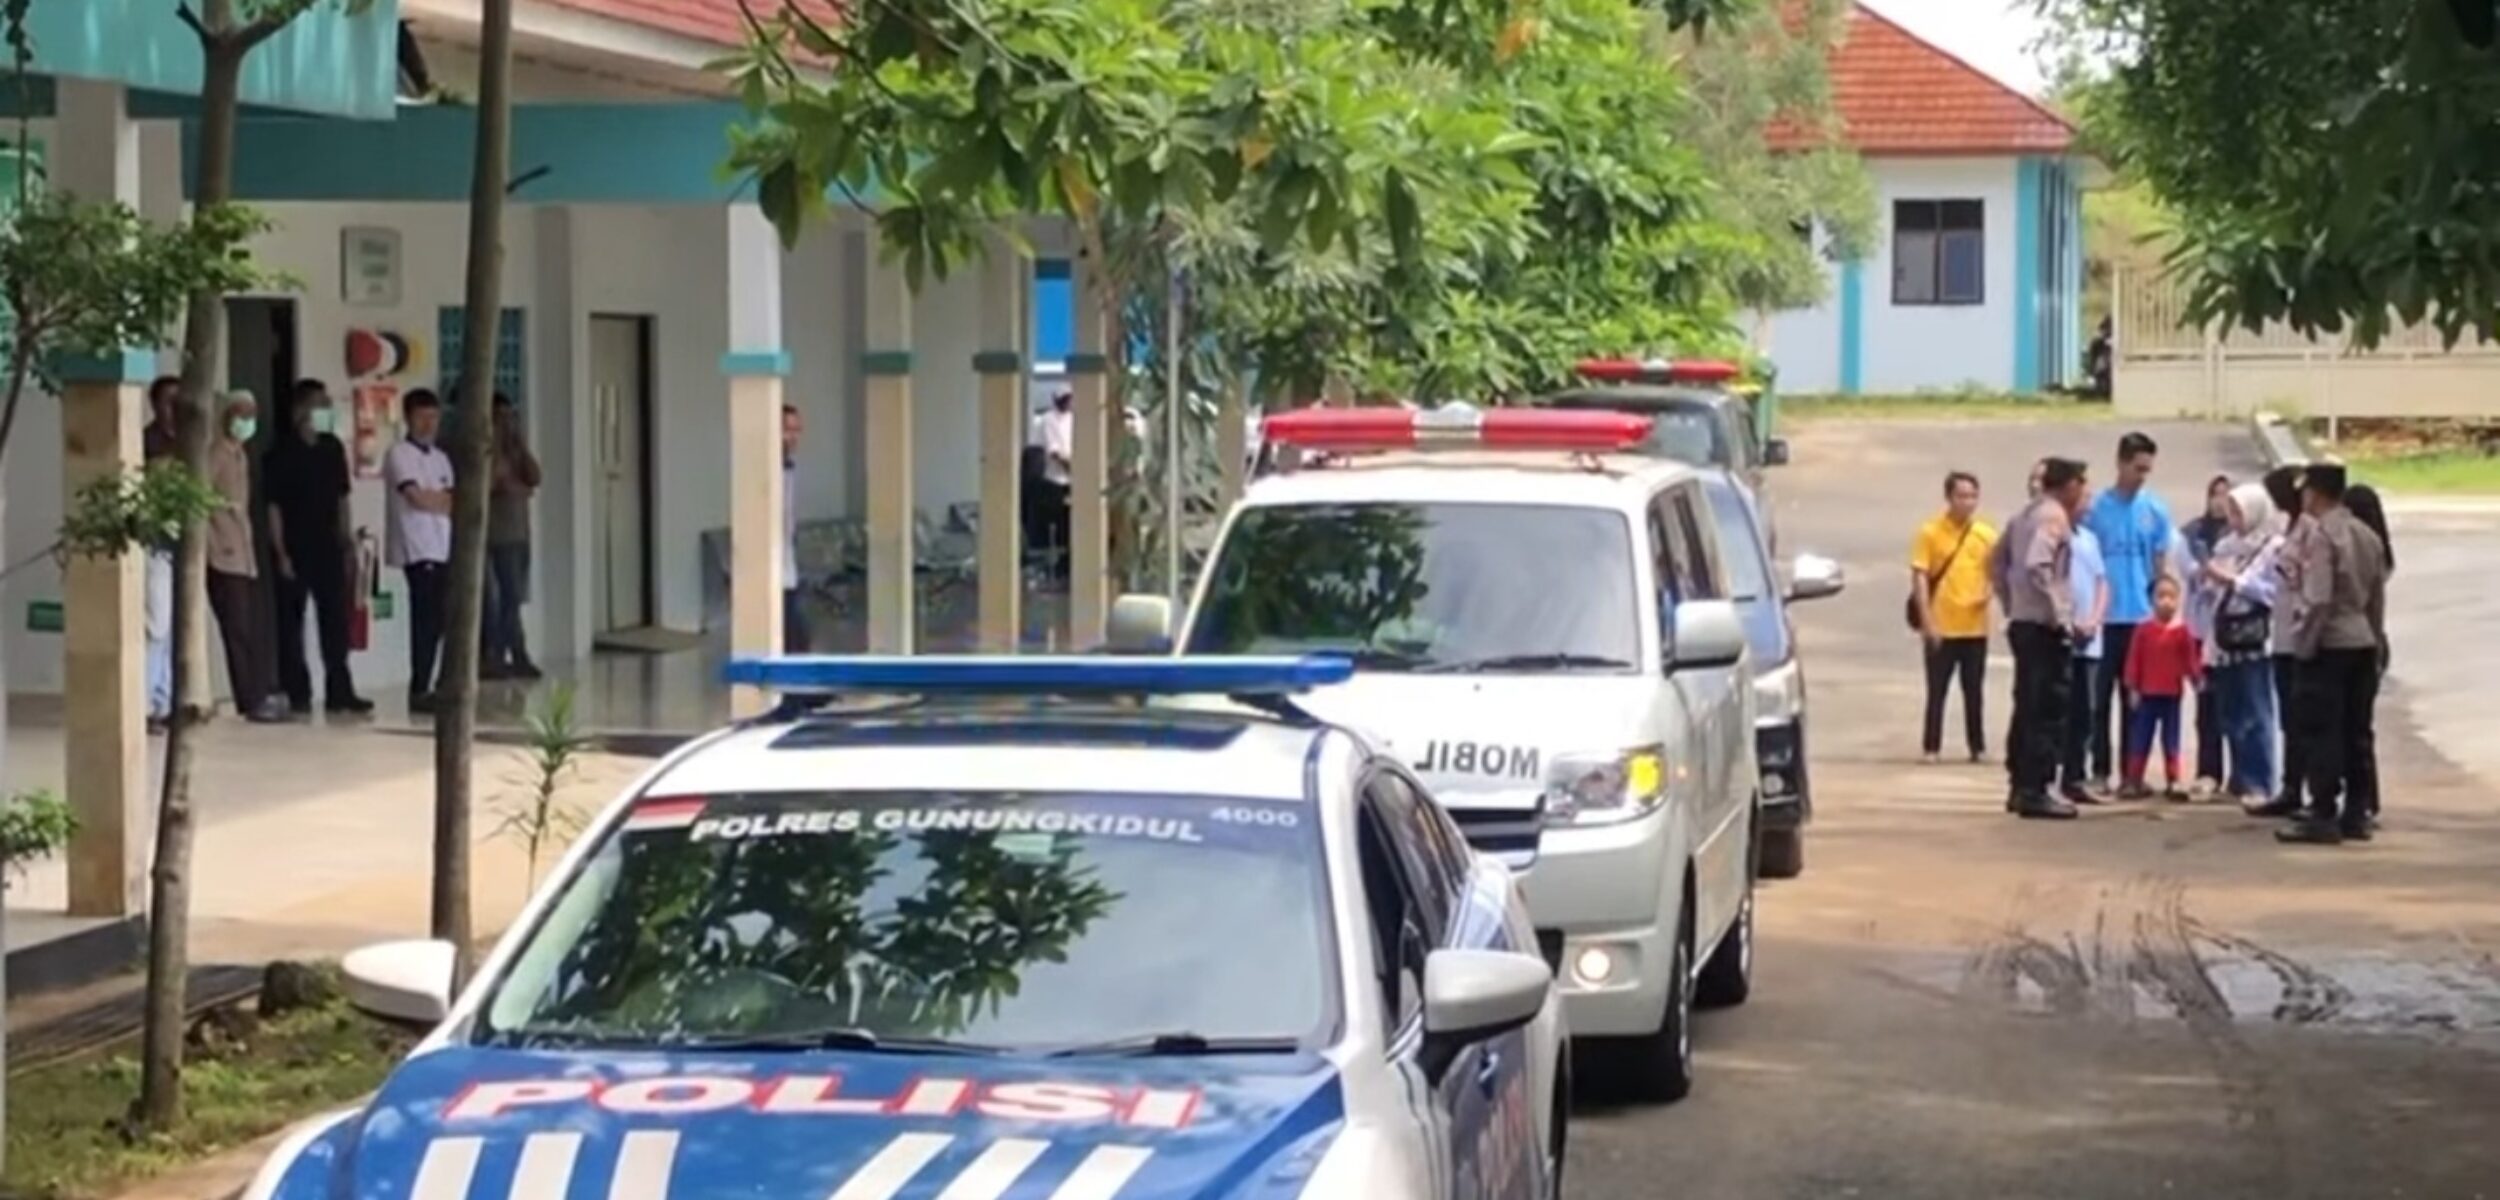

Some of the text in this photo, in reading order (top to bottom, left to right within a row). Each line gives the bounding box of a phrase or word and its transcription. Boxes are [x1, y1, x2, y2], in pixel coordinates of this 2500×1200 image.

[690, 809, 1203, 843] POLRES GUNUNGKIDUL
[1210, 806, 1298, 828] 4000
[440, 1074, 1200, 1128] POLISI
